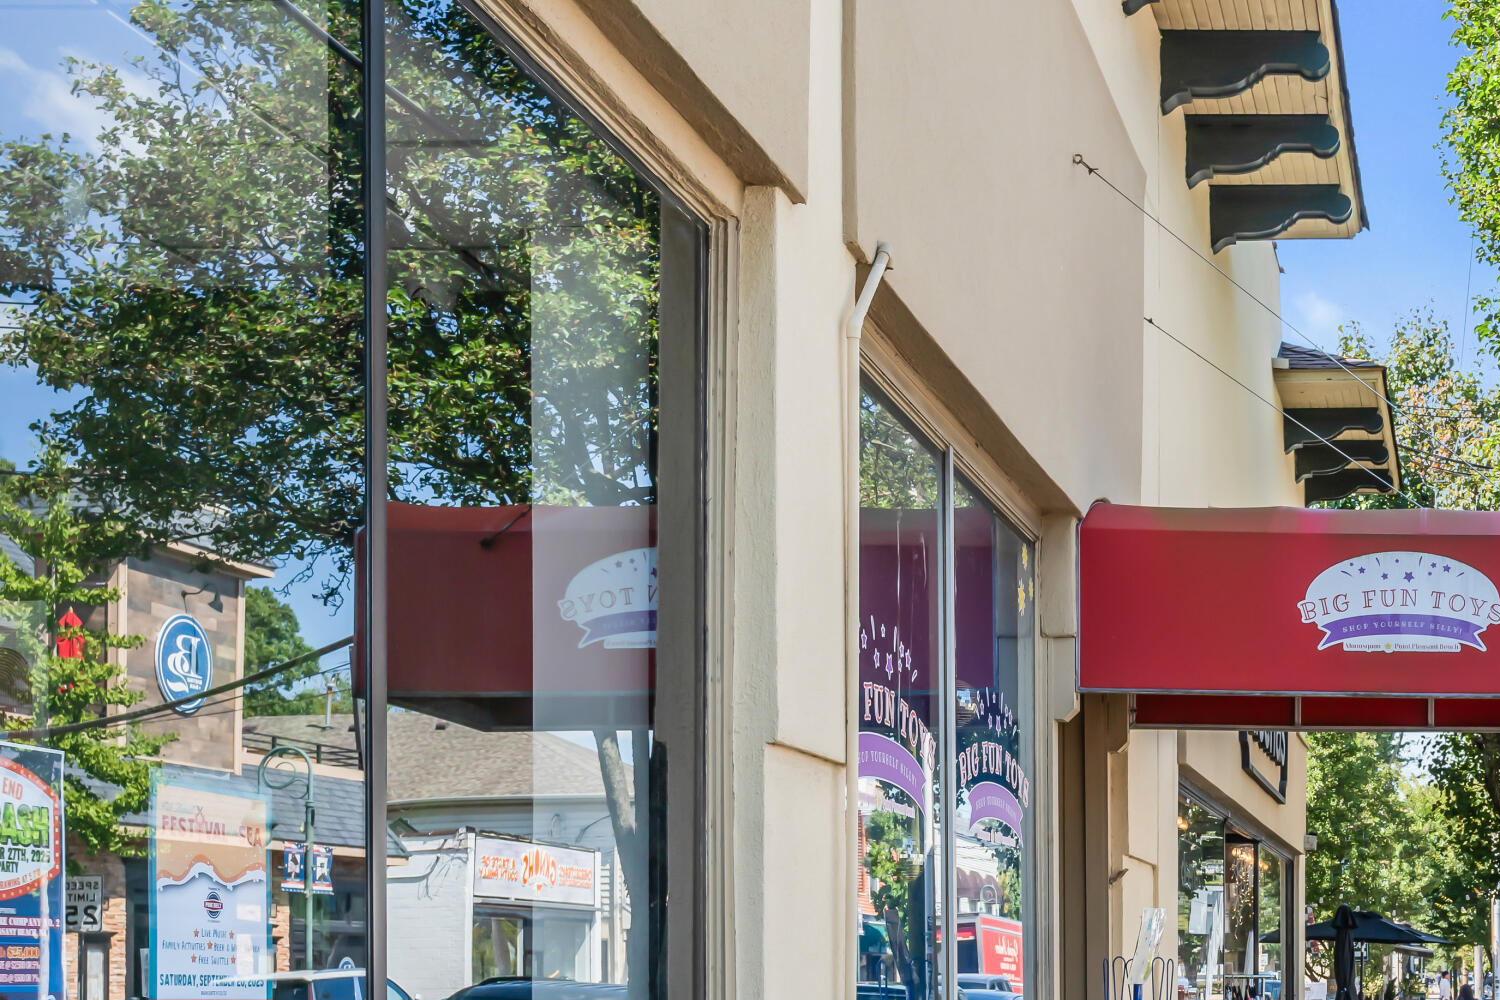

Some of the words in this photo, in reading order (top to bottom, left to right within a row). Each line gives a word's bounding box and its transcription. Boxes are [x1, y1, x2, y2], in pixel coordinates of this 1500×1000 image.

[1301, 593, 1350, 621] BIG
[1362, 589, 1418, 609] FUN
[1342, 623, 1369, 634] SHOP
[1373, 620, 1425, 630] YOURSELF
[1429, 623, 1463, 636] SILLY!
[1394, 642, 1410, 650] Point
[1410, 642, 1438, 650] Pleasant
[1439, 642, 1460, 650] Beach
[863, 681, 895, 728] FUN
[900, 698, 937, 772] TOYS
[871, 750, 899, 770] YOURSELF
[959, 742, 980, 787] BIG
[982, 741, 1003, 776] FUN
[1005, 751, 1030, 808] TOYS
[2, 776, 23, 800] END
[161, 814, 226, 836] FESTIVAL
[8, 847, 29, 863] 27TH,
[31, 850, 50, 863] 2025
[159, 973, 199, 988] SATURDAY,
